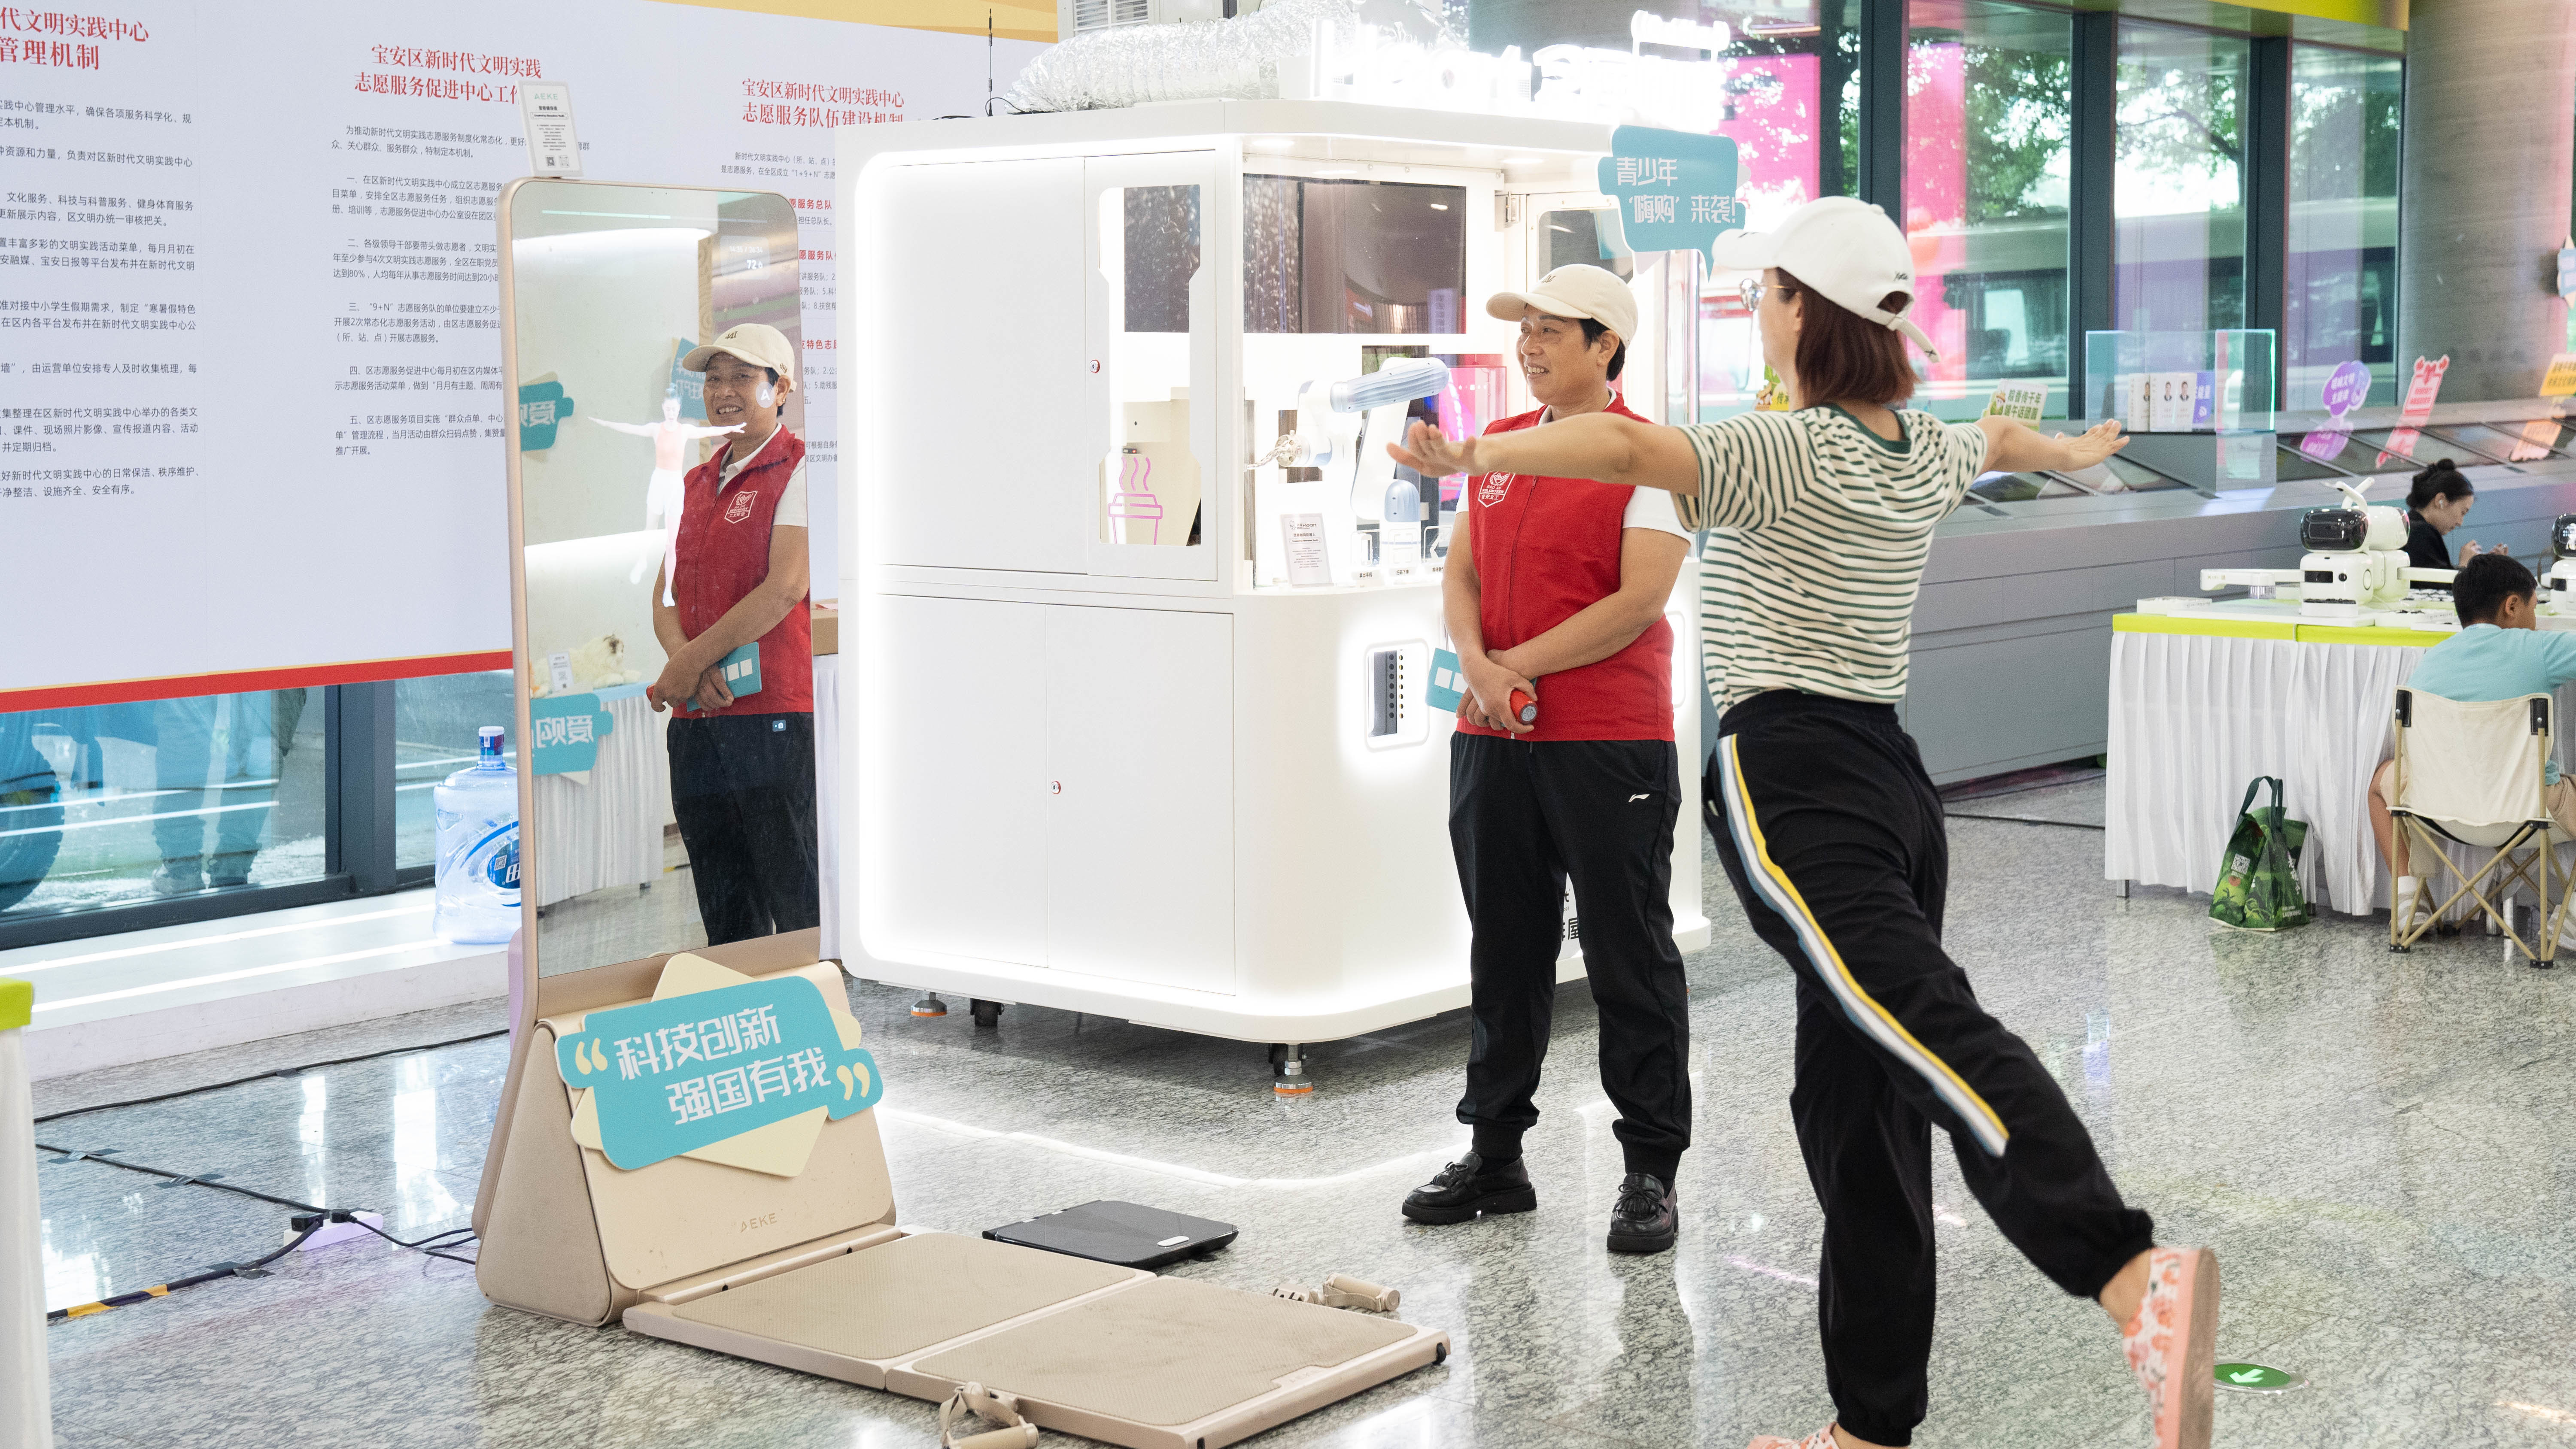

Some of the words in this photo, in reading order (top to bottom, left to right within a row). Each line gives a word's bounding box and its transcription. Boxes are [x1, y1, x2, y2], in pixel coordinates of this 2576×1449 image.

[0, 6, 149, 42] 代文明实践中心
[0, 37, 99, 70] 管理机制
[372, 44, 542, 79] 宝安区新时代文明实践
[742, 78, 905, 108] 宝安区新时代文明实践中心
[346, 124, 526, 146] 为推动新时代文明实践志愿服务制度化常态化，更好
[331, 139, 474, 158] 众、关心群众、服务群众，特制定本机制。
[1616, 157, 1678, 187] 青少年
[346, 175, 507, 192] 一、在区新时代文明实践中心成立区志愿服务
[7, 191, 194, 211] 文化服务、科技与科普服务、健身体育服务
[332, 204, 497, 222] 册、培训等，志愿服务促进中心办公室设在团区
[799, 249, 836, 261] 愿服务队
[0, 255, 194, 271] 安融媒、宝安日报等平台发布并在新时代文明
[747, 259, 757, 269] 72
[800, 272, 835, 281] 讲服务队；2
[800, 287, 836, 295] 务队；5.科
[2, 318, 196, 330] 在区内各平台发布并在新时代文明实践中心公
[804, 367, 837, 375] 务队；2.公
[0, 407, 198, 419] 集整理在区新时代文明实践中心举办的各类文
[350, 414, 504, 425] 五、区志愿服务项目实施“群众点单、中心
[0, 423, 198, 437] 、课件、现场照片影像、宣传报道内容、活动
[3, 442, 57, 453] 并定期归档。
[336, 446, 371, 456] 推广开展。
[0, 467, 200, 481] 好新时代文明实践中心的日常保洁、秩序维护、
[0, 484, 135, 498] 净整洁、设施齐全、安全有序。
[614, 1004, 781, 1082] 科技创新
[665, 1047, 831, 1125] 强国有我
